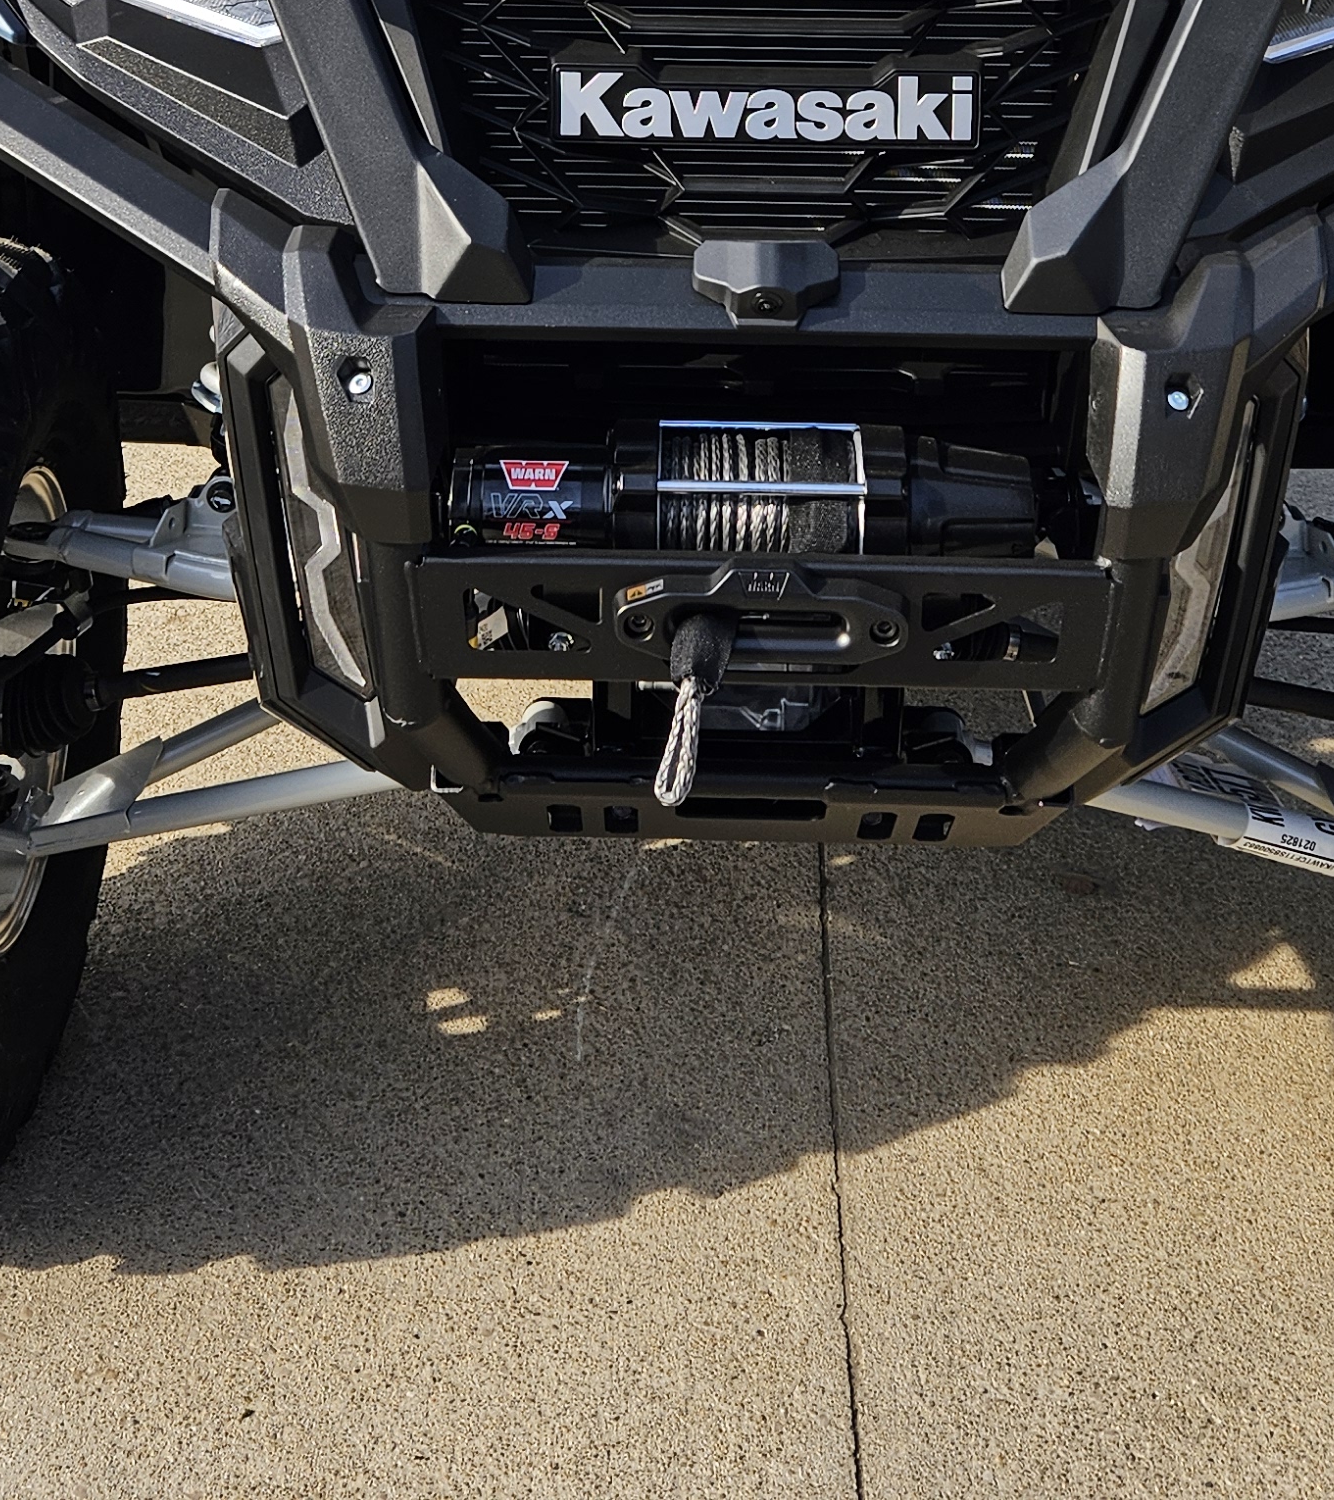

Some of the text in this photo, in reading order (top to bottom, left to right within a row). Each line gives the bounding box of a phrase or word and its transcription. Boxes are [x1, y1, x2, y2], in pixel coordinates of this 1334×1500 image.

[559, 71, 974, 142] Kawasaki
[510, 467, 557, 480] WARN
[503, 522, 561, 540] 45-S
